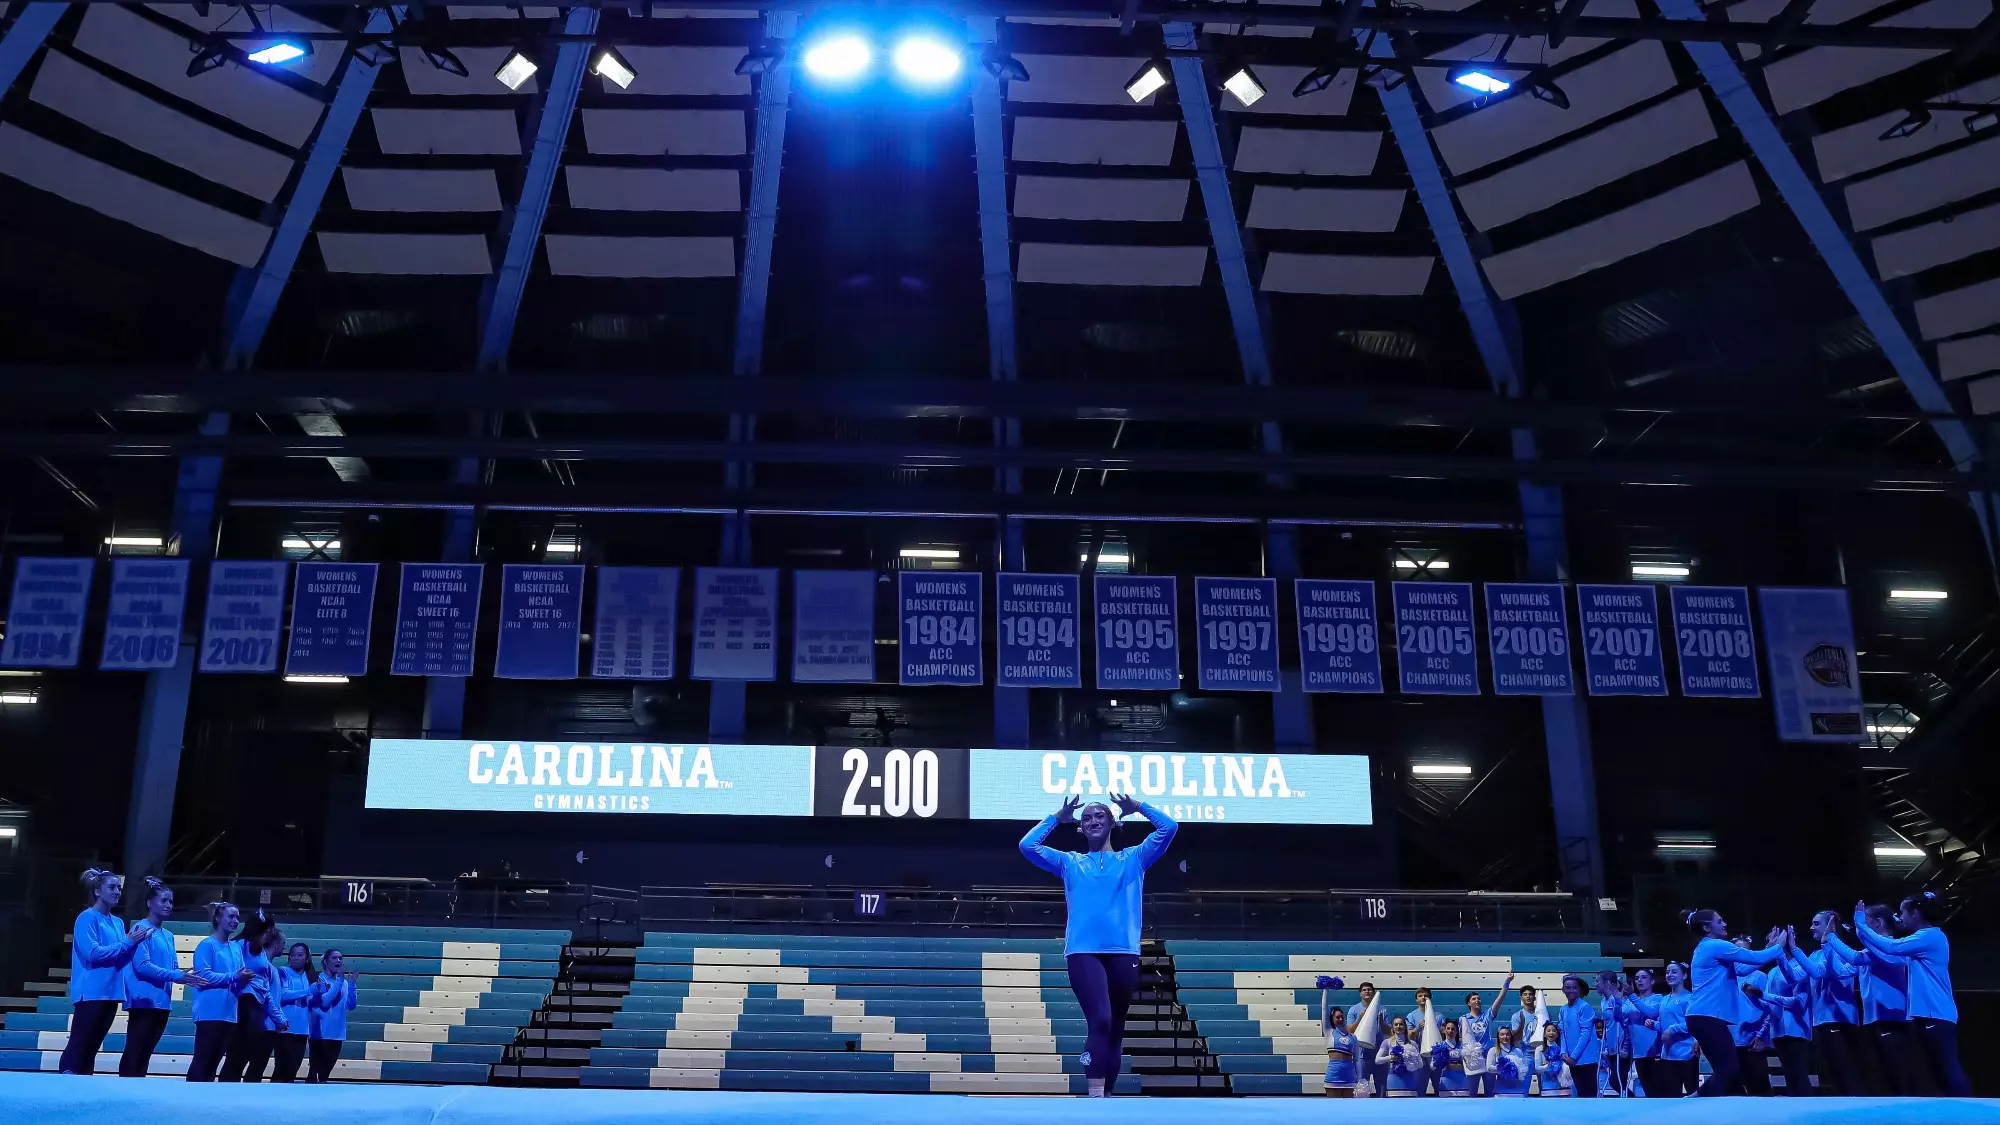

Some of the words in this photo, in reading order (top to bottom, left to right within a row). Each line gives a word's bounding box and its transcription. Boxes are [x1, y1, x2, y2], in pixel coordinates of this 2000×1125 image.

[308, 583, 361, 593] BASKETBALL
[413, 582, 467, 592] BASKETBALL
[514, 583, 570, 593] BASKETBALL
[321, 597, 345, 605] NCAA
[427, 595, 451, 604] NCAA
[529, 596, 553, 605] NCAA
[906, 599, 975, 612] BASKETBALL
[417, 608, 447, 617] SWEET
[450, 608, 459, 617] 16
[1004, 600, 1072, 613] BASKETBALL
[1101, 603, 1170, 615] BASKETBALL
[1203, 604, 1271, 617] BASKETBALL
[317, 609, 339, 618] ELITE
[519, 609, 550, 618] SWEET
[552, 609, 561, 618] 16
[1303, 607, 1370, 619] BASKETBALL
[1401, 609, 1468, 621] BASKETBALL
[1493, 610, 1559, 622] BASKETBALL
[1587, 612, 1652, 624] BASKETBALL
[1680, 613, 1745, 625] BASKETBALL
[905, 616, 976, 645] 1984
[1003, 617, 1074, 647] 1994
[1100, 619, 1173, 649] 1995
[1204, 621, 1271, 651] 1997
[1303, 623, 1375, 653] 1998
[1401, 625, 1472, 655] 2005
[1494, 627, 1565, 656] 2006
[1588, 628, 1654, 656] 2007
[1681, 629, 1750, 658] 2008
[207, 638, 272, 665] 2007
[930, 648, 953, 660] ACC
[1027, 650, 1050, 661] ACC
[1126, 652, 1149, 663] ACC
[1228, 653, 1251, 665] ACC
[1329, 656, 1352, 667] ACC
[1427, 658, 1450, 669] ACC
[1521, 658, 1543, 670] ACC
[1614, 659, 1636, 670] ACC
[908, 664, 975, 676] CHAMPIONS
[1005, 666, 1073, 678] CHAMPIONS
[1708, 662, 1731, 673] ACC
[1104, 668, 1171, 680] CHAMPIONS
[1206, 669, 1273, 682] CHAMPIONS
[1309, 672, 1374, 684] CHAMPIONS
[1407, 673, 1471, 686] CHAMPIONS
[1501, 674, 1566, 687] CHAMPIONS
[1595, 675, 1659, 687] CHAMPIONS
[1688, 676, 1752, 689] CHAMPIONS
[468, 743, 719, 789] CAROLINA
[1042, 752, 1292, 798] CAROLINA
[842, 748, 939, 818] 2:00
[534, 794, 651, 811] GYMNASTICS
[347, 882, 368, 903] 116
[861, 894, 880, 914] 117
[1365, 898, 1387, 919] 118
